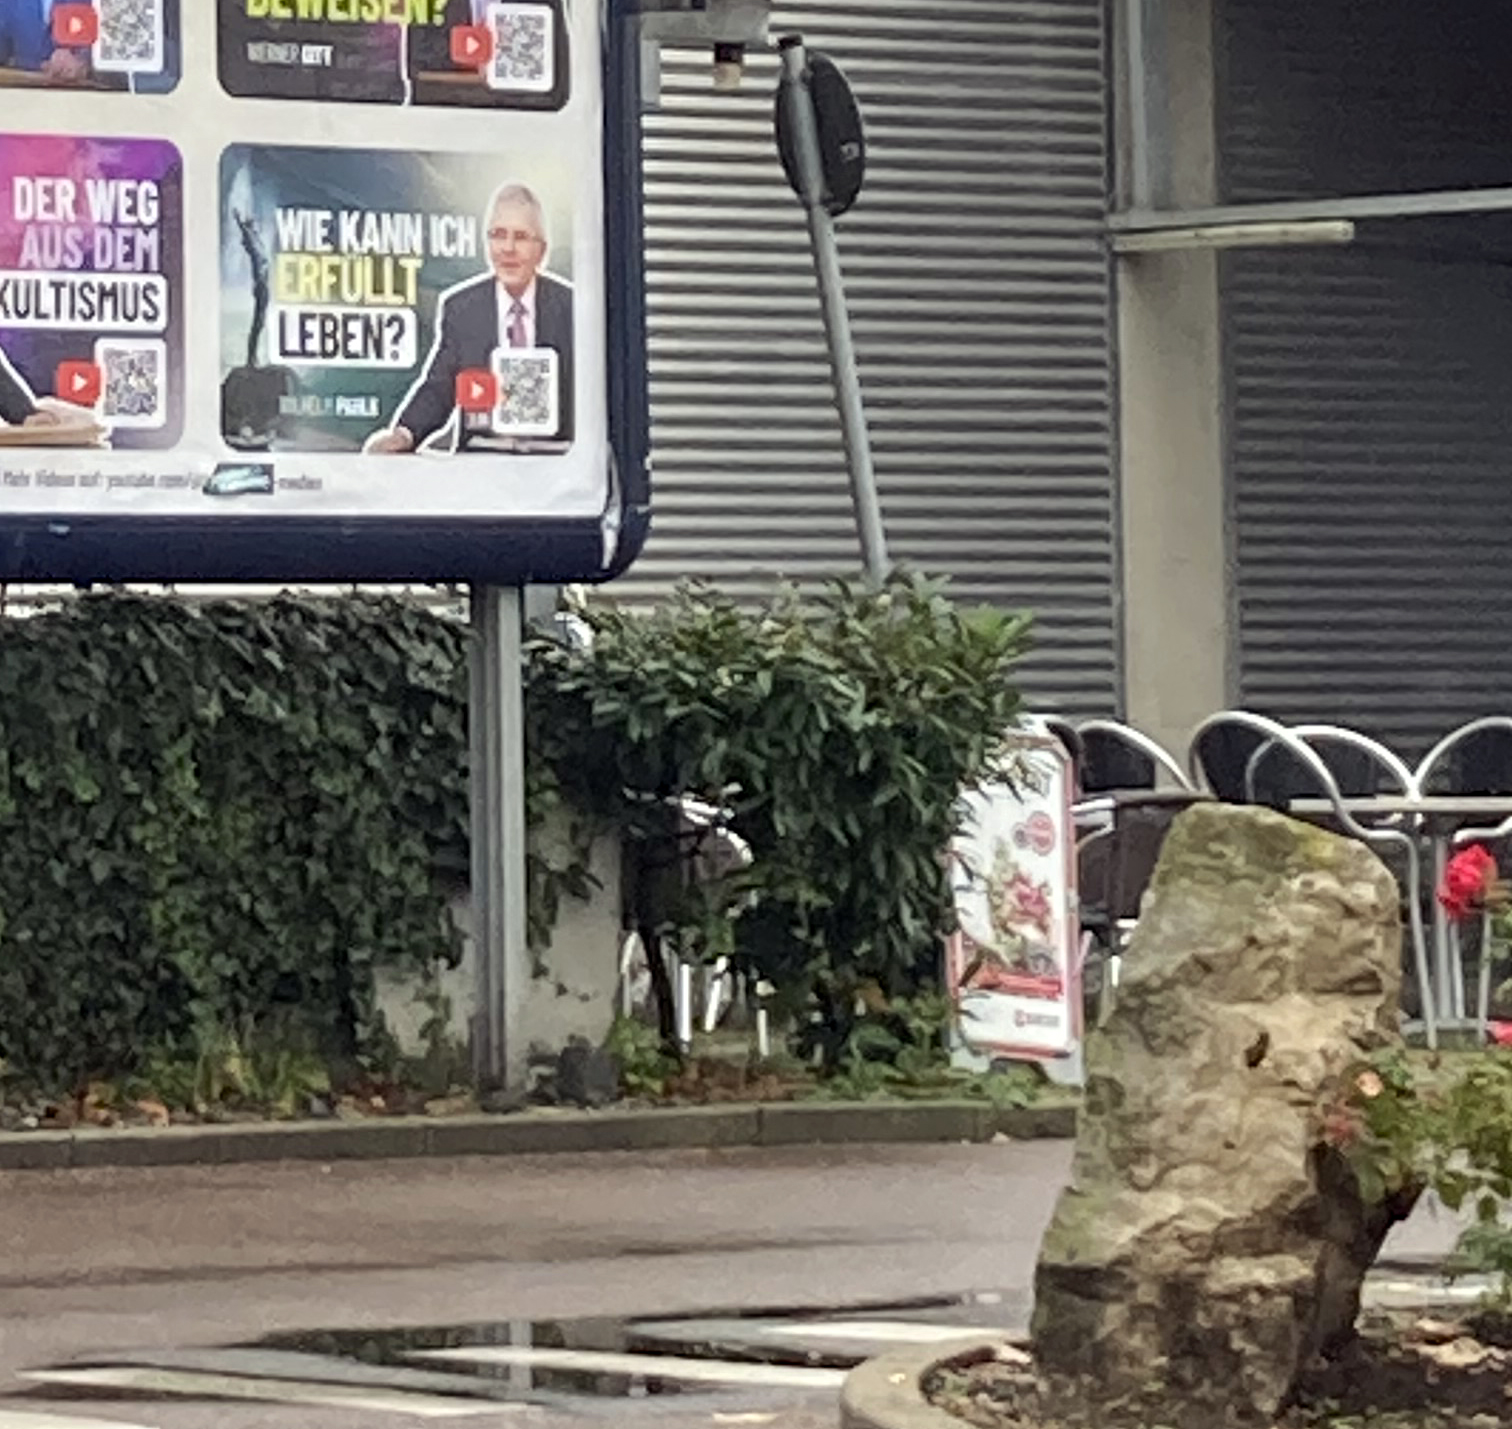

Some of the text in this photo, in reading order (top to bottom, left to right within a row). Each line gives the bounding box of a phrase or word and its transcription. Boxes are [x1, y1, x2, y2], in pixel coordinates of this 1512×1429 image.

[12, 175, 159, 227] DER WEG
[18, 224, 159, 272] AUS DEM
[275, 207, 478, 259] WIE KANN ICH
[273, 252, 424, 307] ERFÜLLT
[278, 309, 407, 361] LEBEN?
